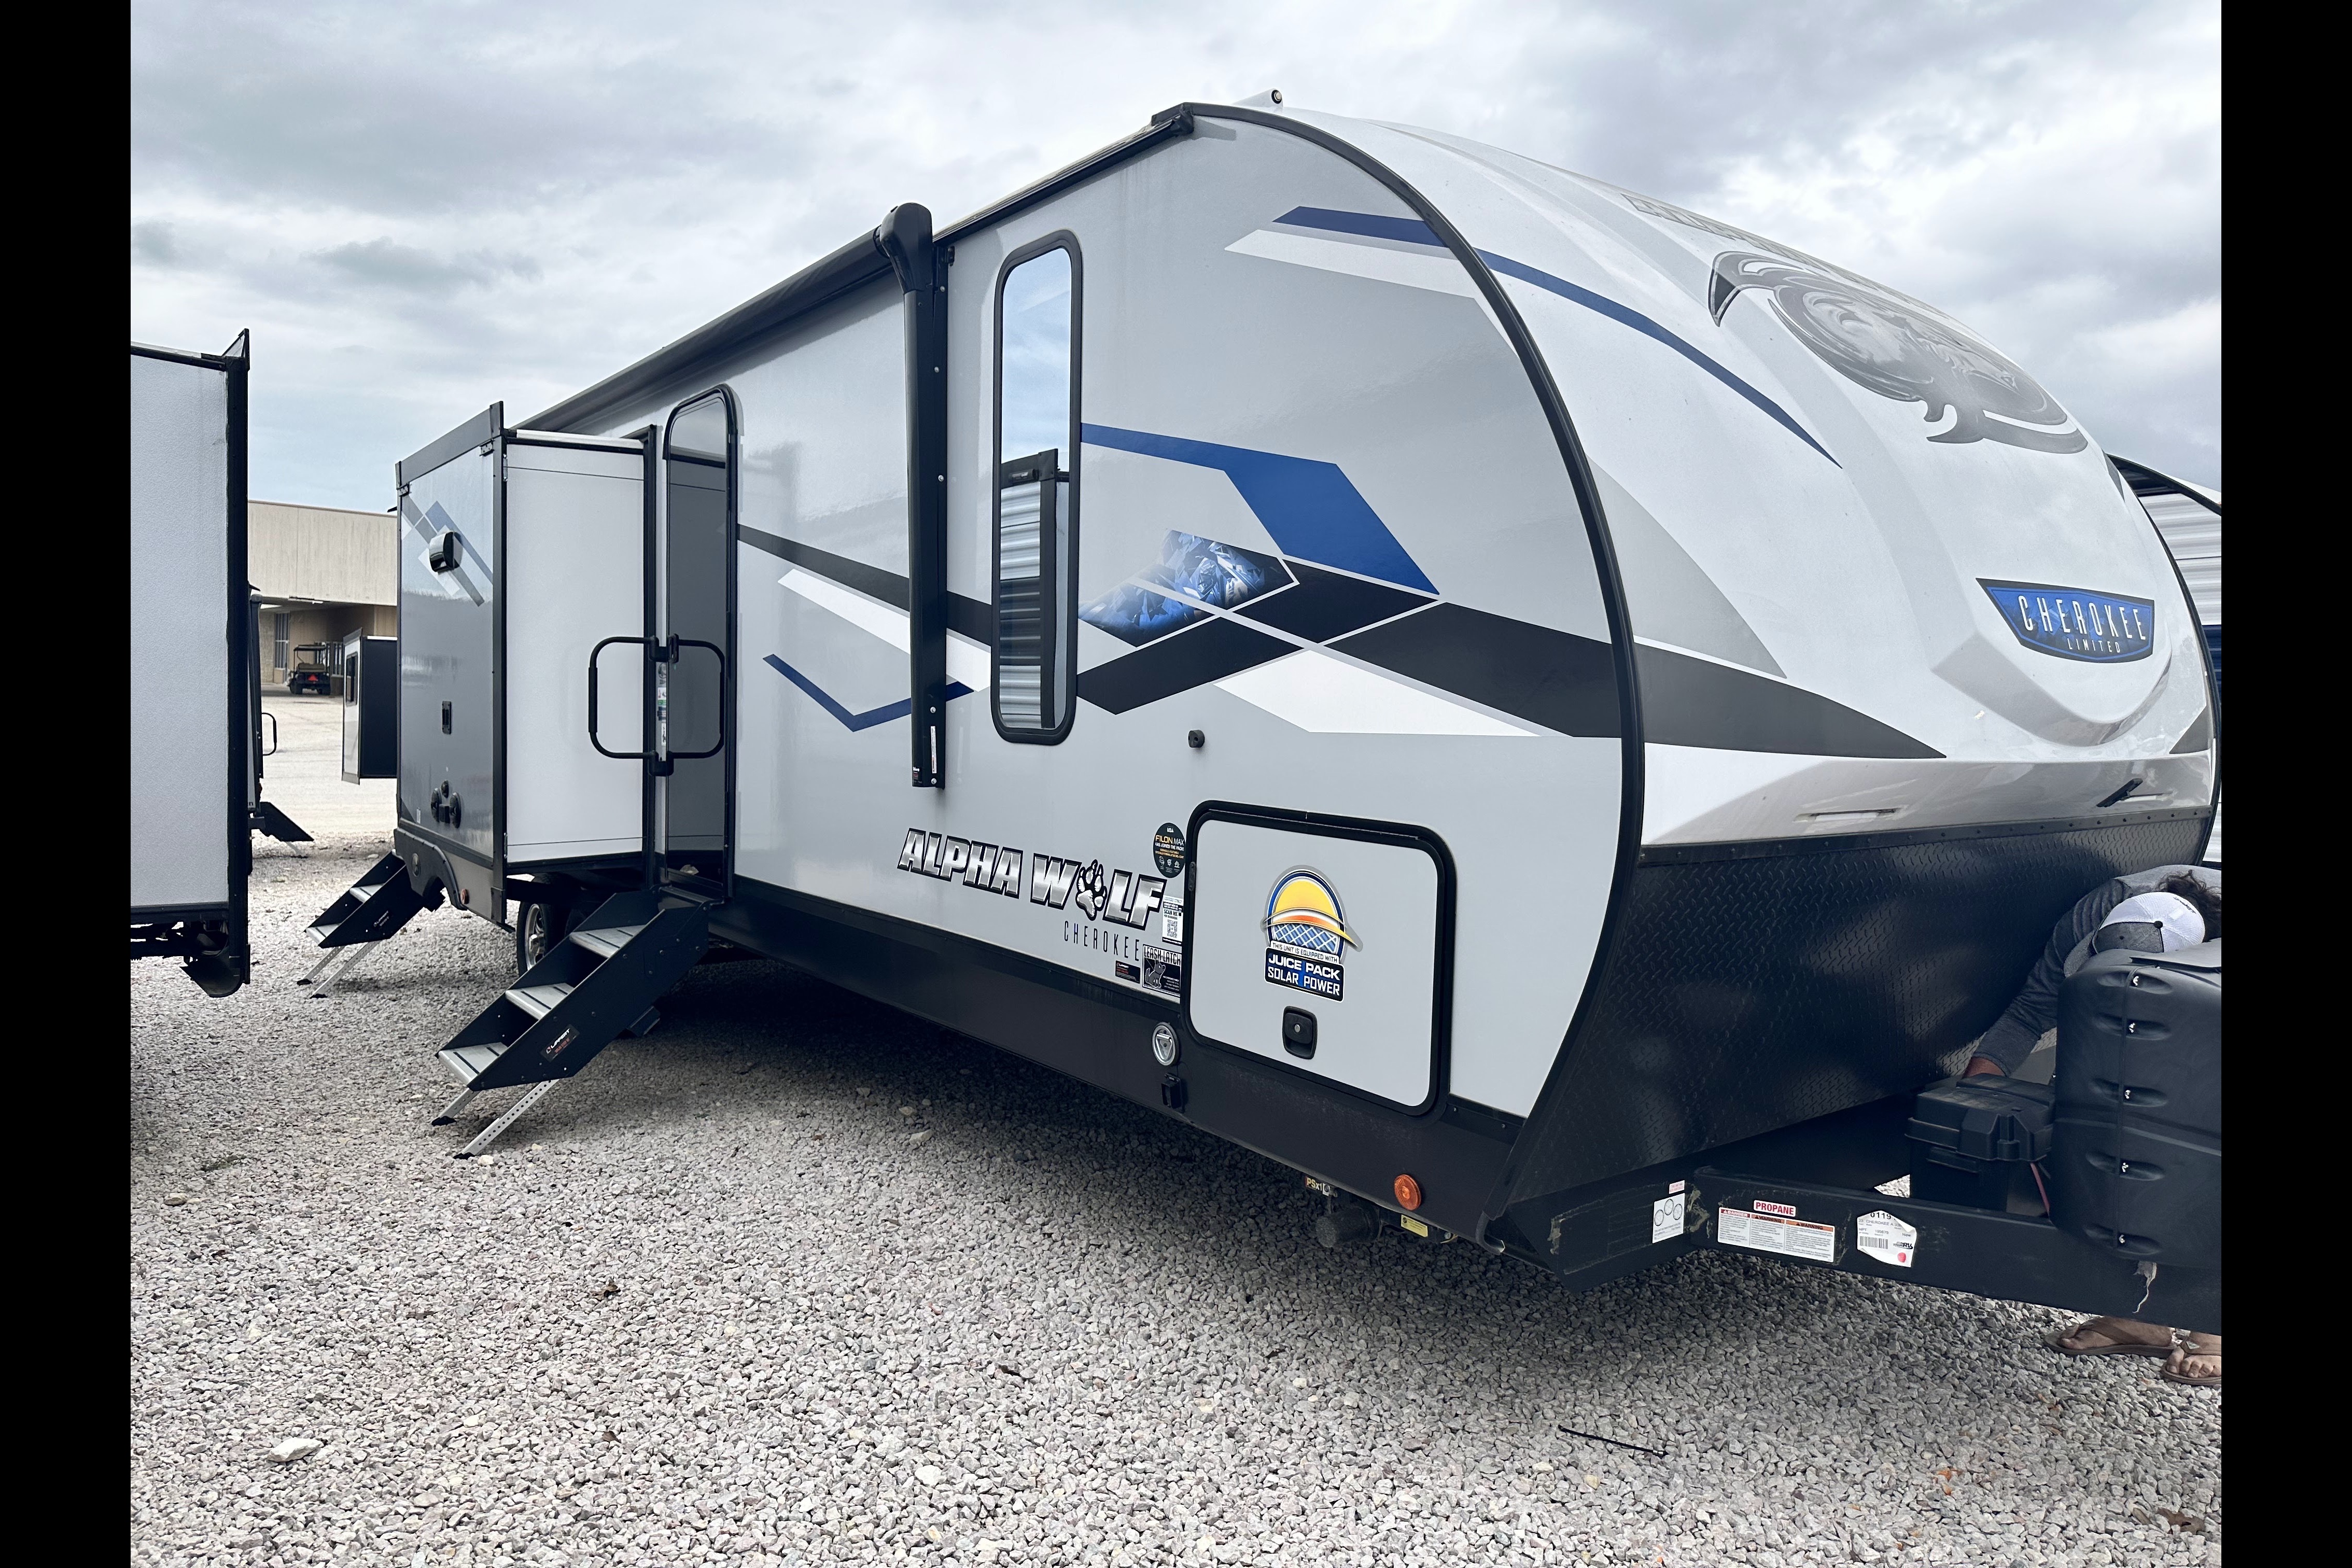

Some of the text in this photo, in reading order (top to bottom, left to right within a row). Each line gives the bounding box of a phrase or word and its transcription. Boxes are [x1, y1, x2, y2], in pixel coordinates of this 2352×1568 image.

[2019, 595, 2146, 640] CHEROKEE
[2067, 638, 2120, 653] LIMITED
[1173, 837, 1184, 846] MAX
[897, 828, 1023, 899] ALPHA
[1065, 920, 1140, 961] CHEROKEE
[1268, 954, 1340, 981] JUICE PACK
[1300, 950, 1324, 960] EQUIPPED
[1268, 966, 1340, 996] SOLAR POWER
[1756, 1202, 1794, 1215] PROPANE
